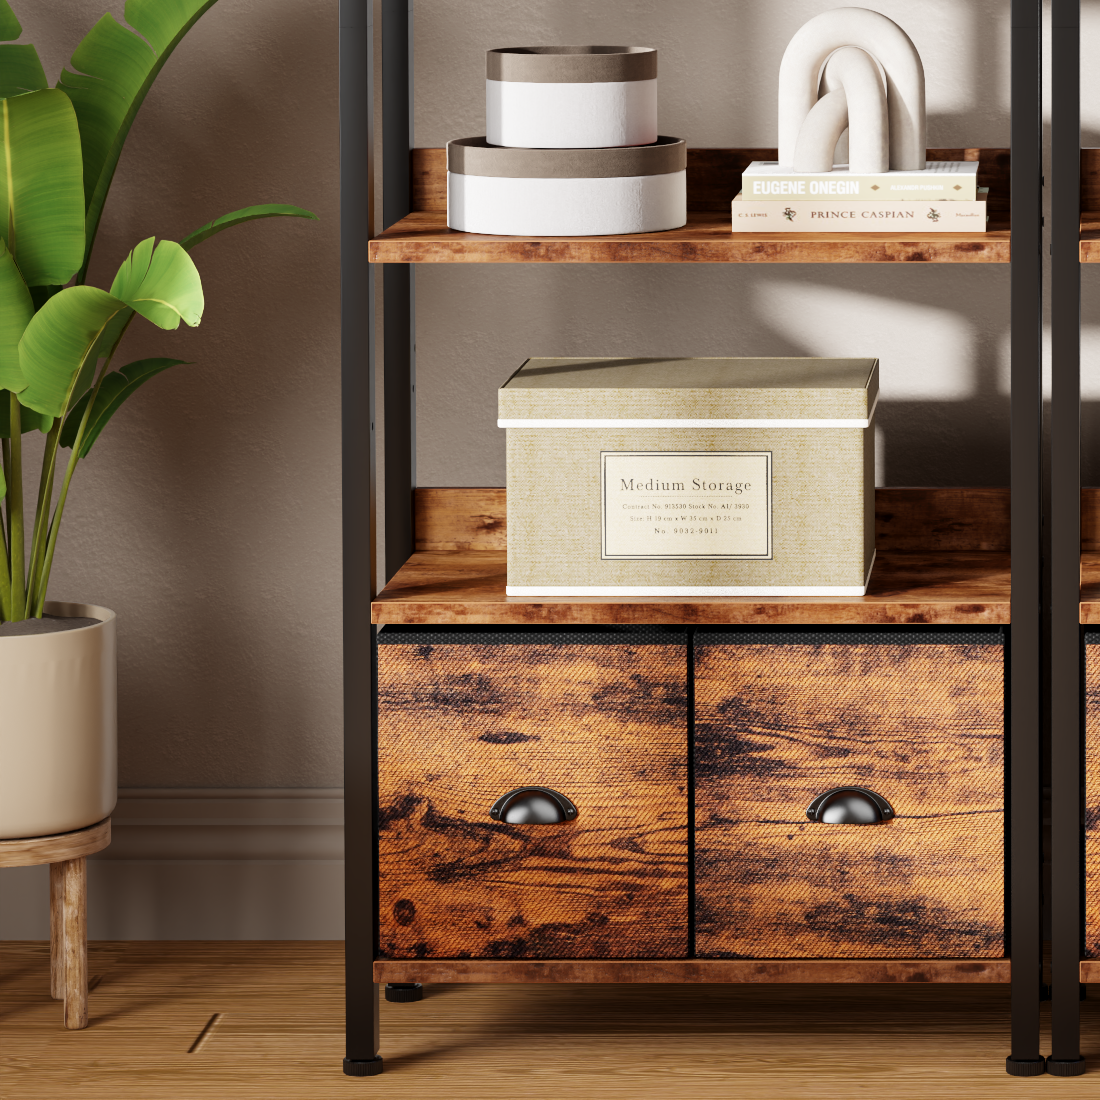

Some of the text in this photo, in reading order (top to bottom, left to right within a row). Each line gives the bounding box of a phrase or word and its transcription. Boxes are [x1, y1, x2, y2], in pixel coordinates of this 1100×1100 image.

[752, 180, 860, 195] EUGENE ONEGIN
[810, 211, 915, 219] PRINCE CASPIAN
[620, 477, 752, 495] Medium Storage
